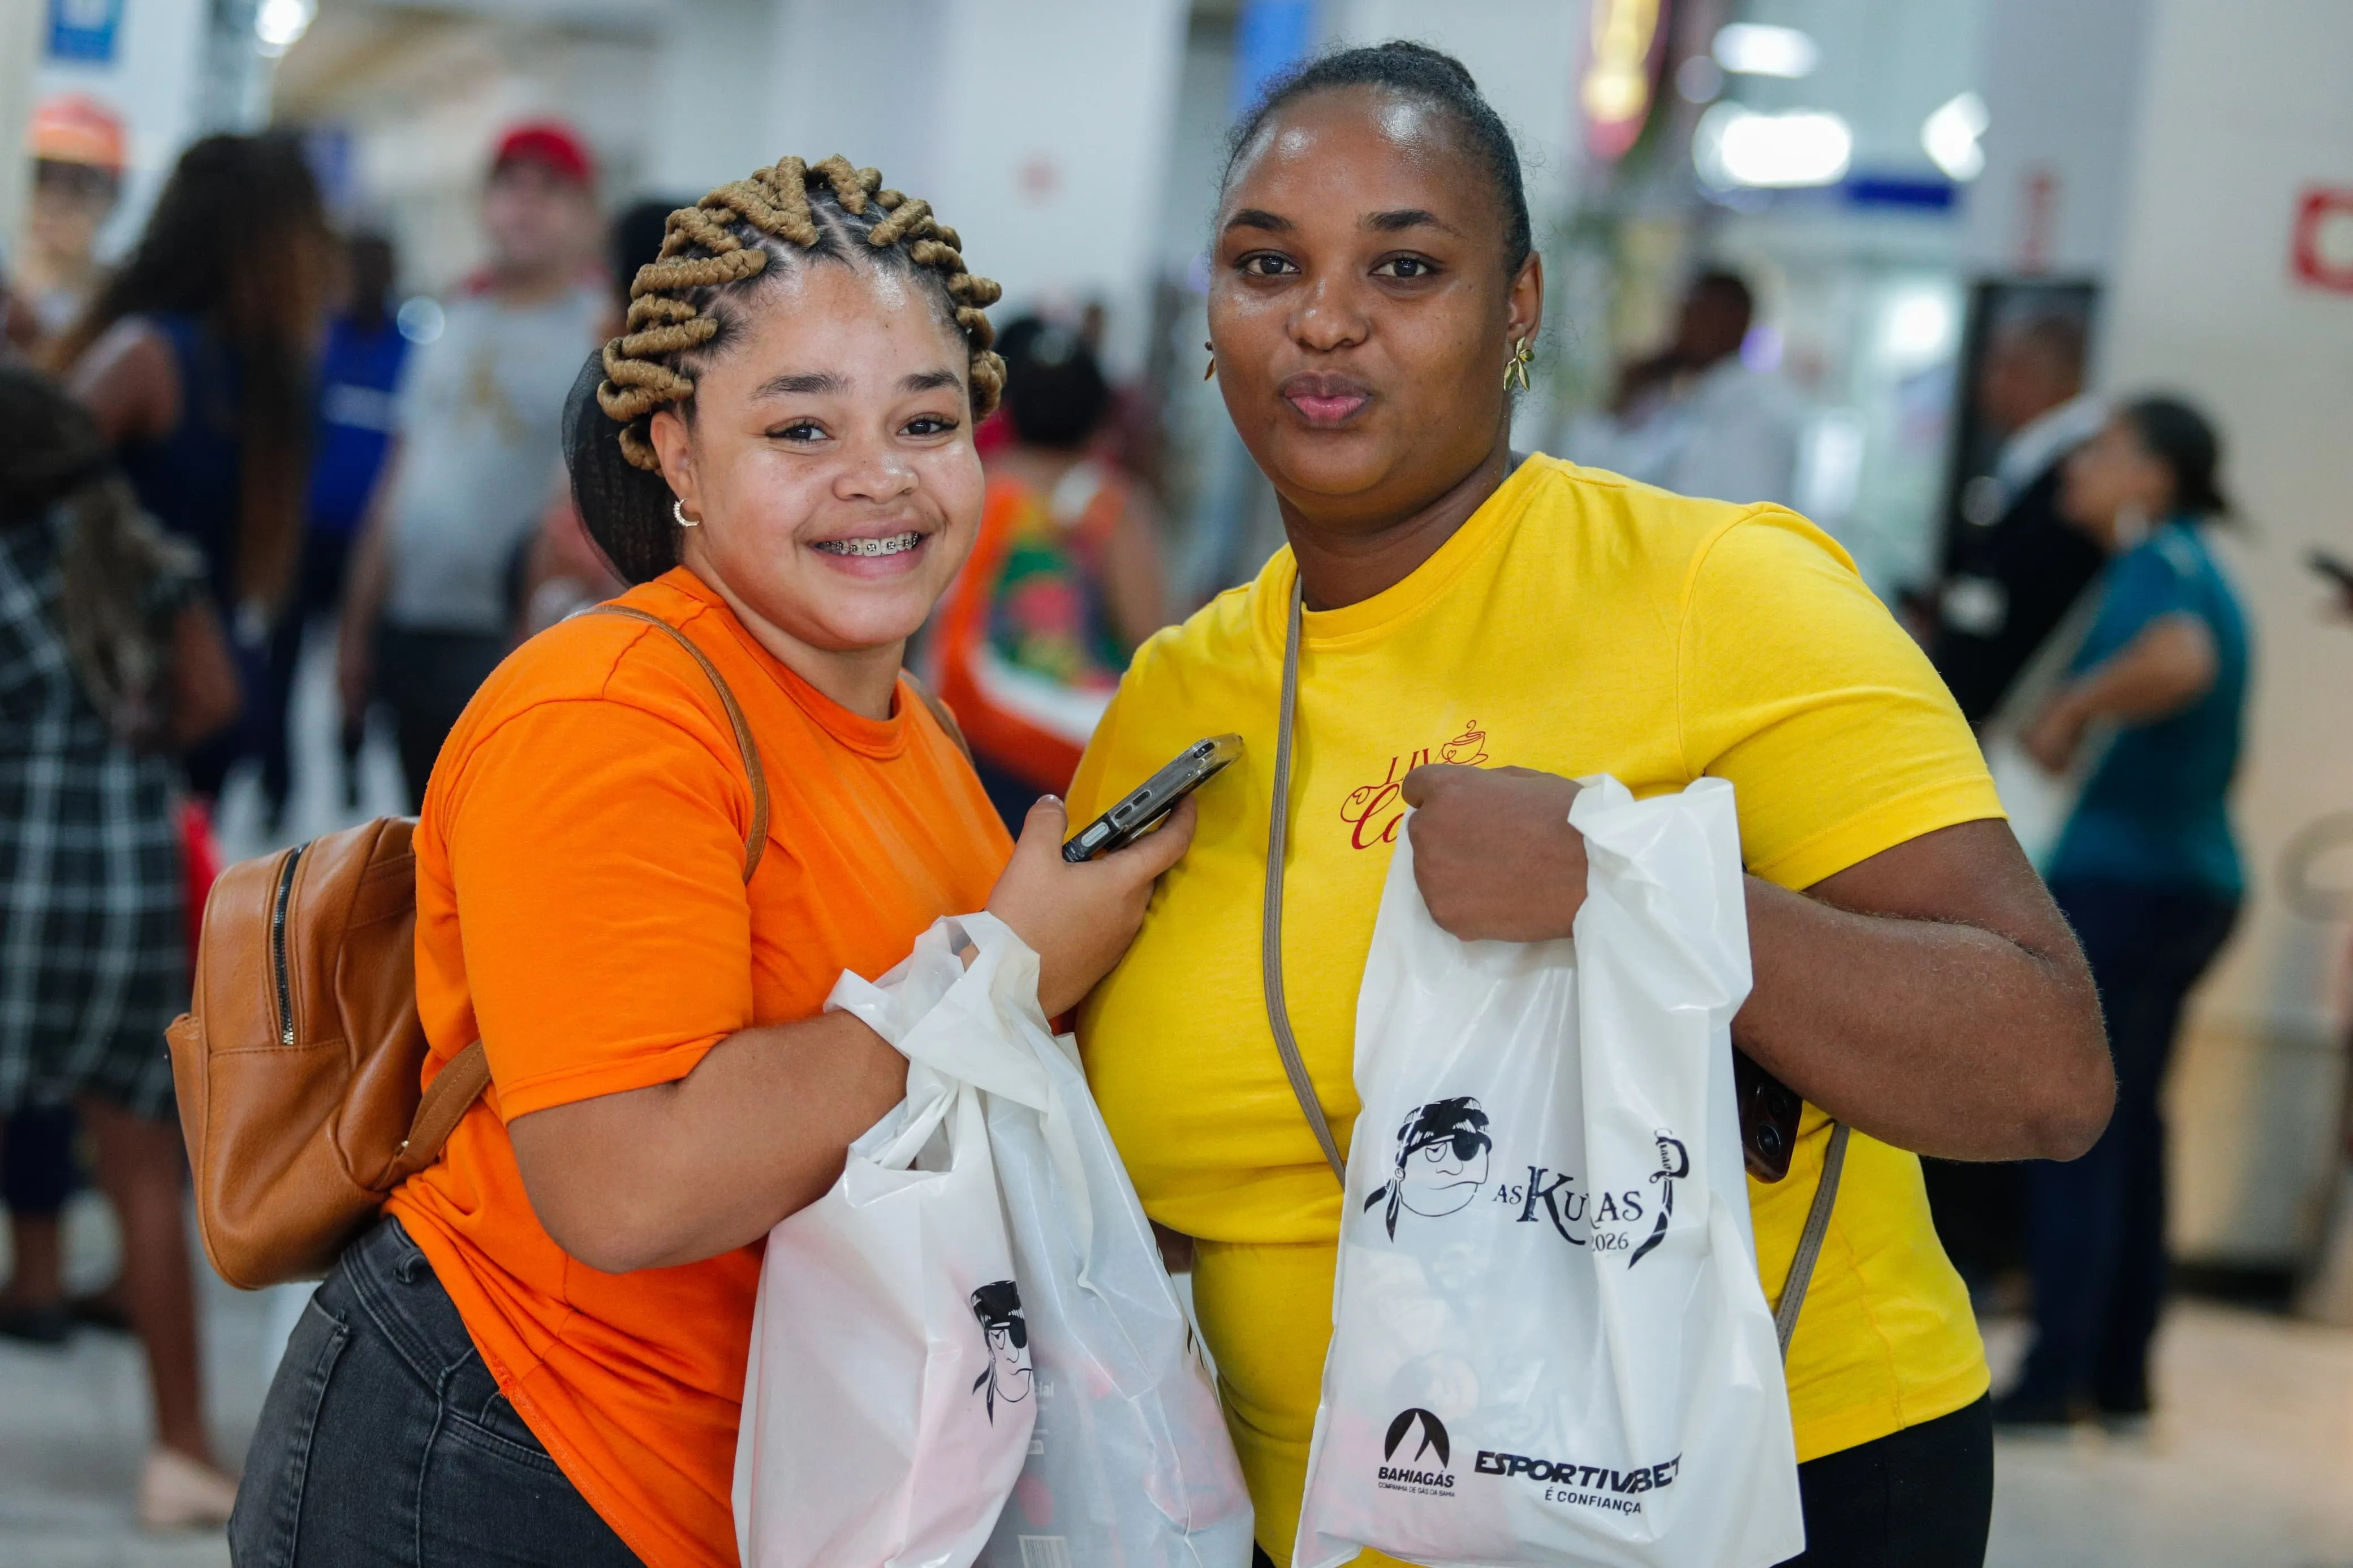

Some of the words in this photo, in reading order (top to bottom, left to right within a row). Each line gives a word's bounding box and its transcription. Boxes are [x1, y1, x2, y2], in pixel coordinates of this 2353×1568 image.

[1492, 1184, 1523, 1204] AS
[1516, 1166, 1643, 1245] KUAS
[1378, 1466, 1455, 1488] BAHIAGÁS
[1378, 1481, 1408, 1492] COMPANHIA
[1545, 1486, 1554, 1501] É
[1557, 1490, 1641, 1515] CONFIANÇA
